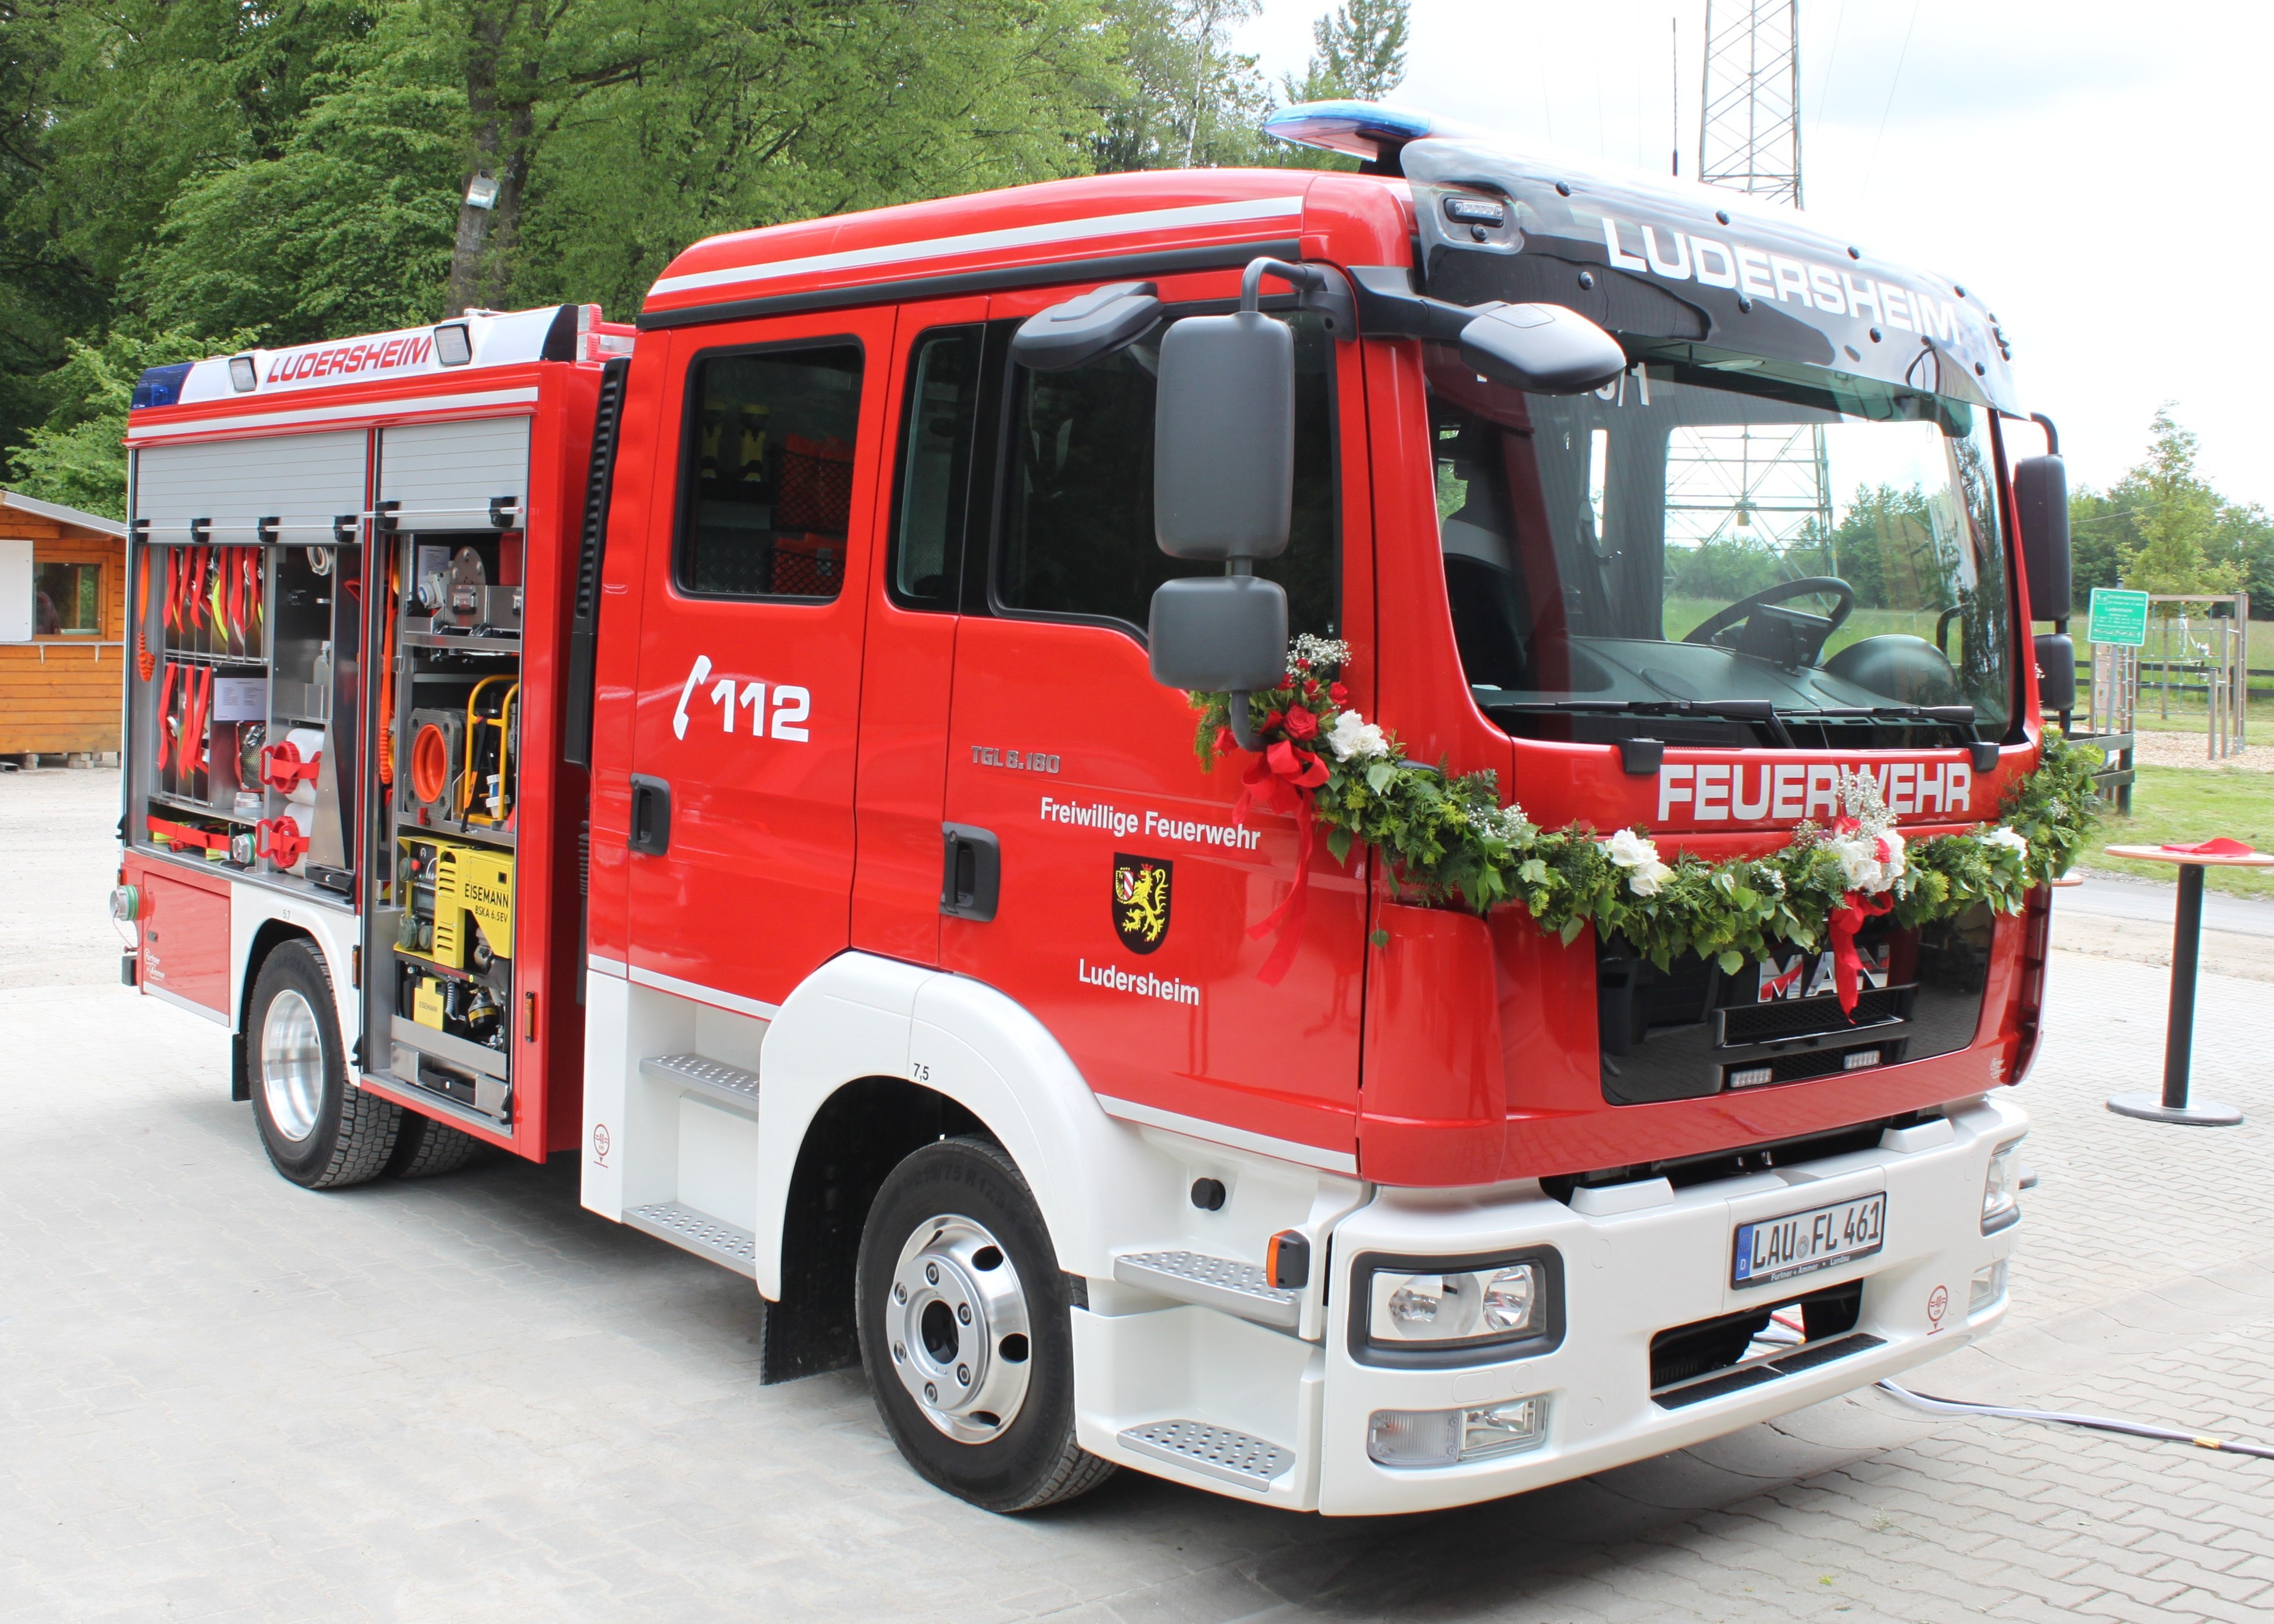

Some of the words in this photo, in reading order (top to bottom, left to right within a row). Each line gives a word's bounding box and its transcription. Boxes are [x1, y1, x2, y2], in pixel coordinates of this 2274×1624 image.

[1601, 217, 1962, 346] LUDERSHEIM
[266, 335, 432, 384] LUDERSHEIM
[711, 679, 811, 743] 112
[971, 745, 1004, 767] TGL
[1005, 750, 1060, 774] 8.180
[1658, 763, 1972, 821] FEUERWEHR
[1041, 797, 1138, 837] Freiwillige
[1145, 810, 1260, 850] Feuerwehr
[464, 883, 509, 909] EISEMANN
[475, 905, 490, 918] BSKA
[1079, 958, 1200, 1006] Ludersheim
[1758, 945, 1890, 1003] MAN
[419, 1001, 438, 1013] EISEMANN
[913, 1062, 929, 1082] 7,5
[1752, 1221, 1797, 1269] LAU
[1811, 1212, 1838, 1255] FL
[1843, 1200, 1880, 1245] 461
[1740, 1258, 1747, 1270] D
[1771, 1271, 1792, 1282] Furtner
[1797, 1263, 1818, 1275] Ammer
[1830, 1255, 1850, 1266] Landau
